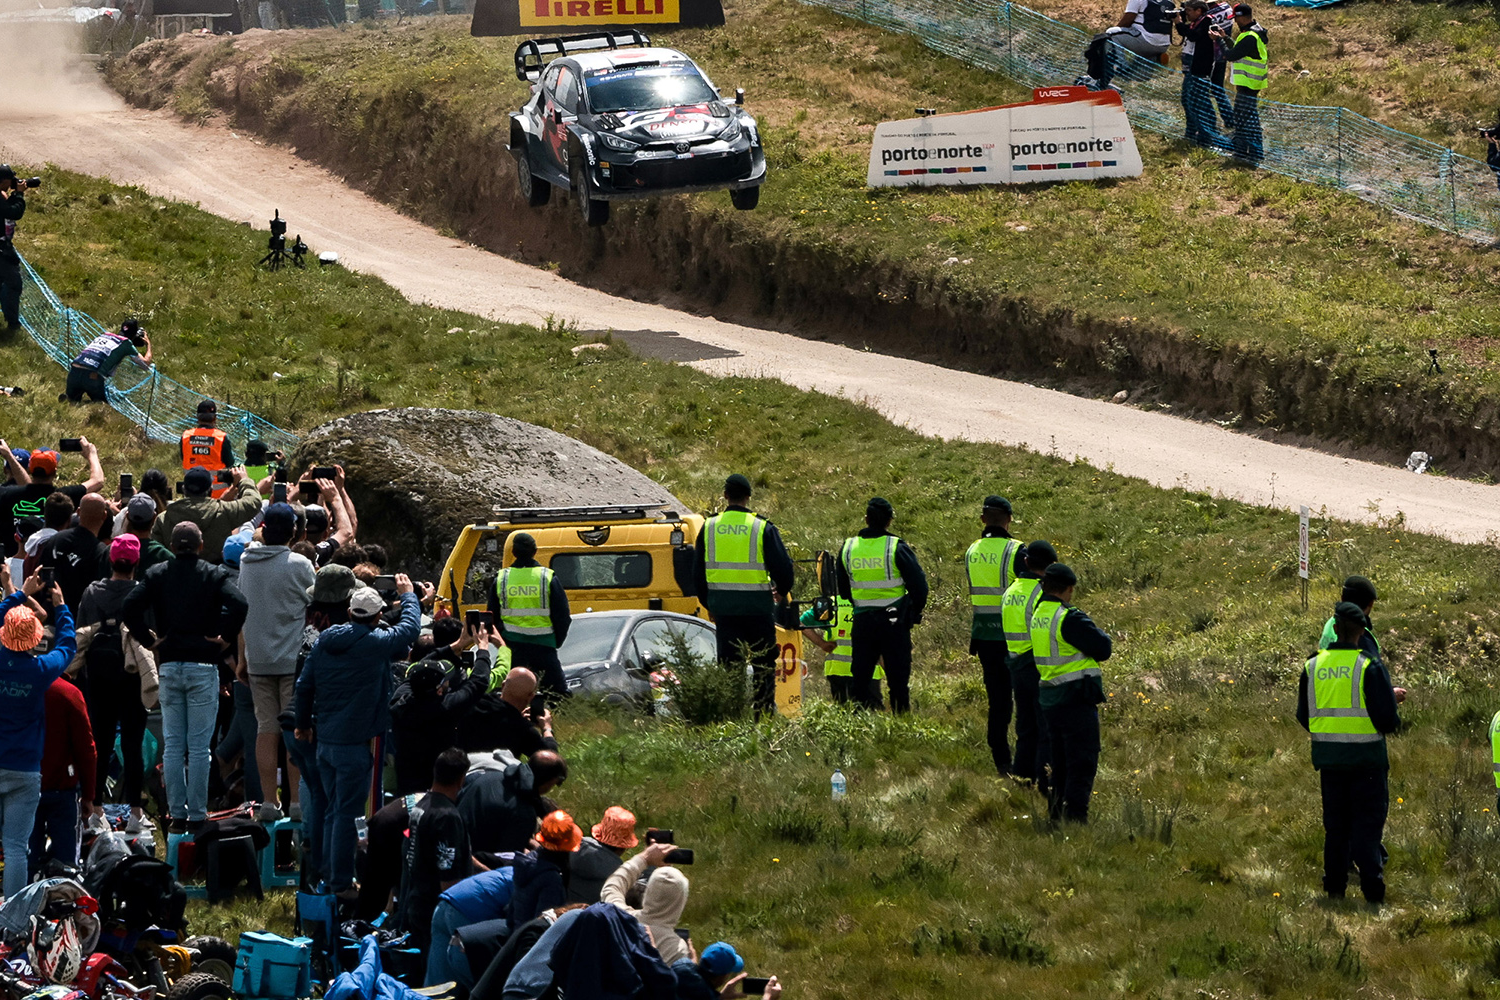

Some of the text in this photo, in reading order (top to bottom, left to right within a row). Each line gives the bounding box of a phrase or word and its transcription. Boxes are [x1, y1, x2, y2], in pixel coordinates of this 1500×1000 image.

[1039, 89, 1070, 97] WRC
[717, 524, 749, 536] GNR
[852, 557, 883, 569] GNR
[969, 552, 998, 565] GNR
[508, 585, 538, 597] GNR
[1004, 594, 1027, 606] GNR
[1031, 617, 1050, 629] GNR
[1317, 666, 1350, 680] GNR
